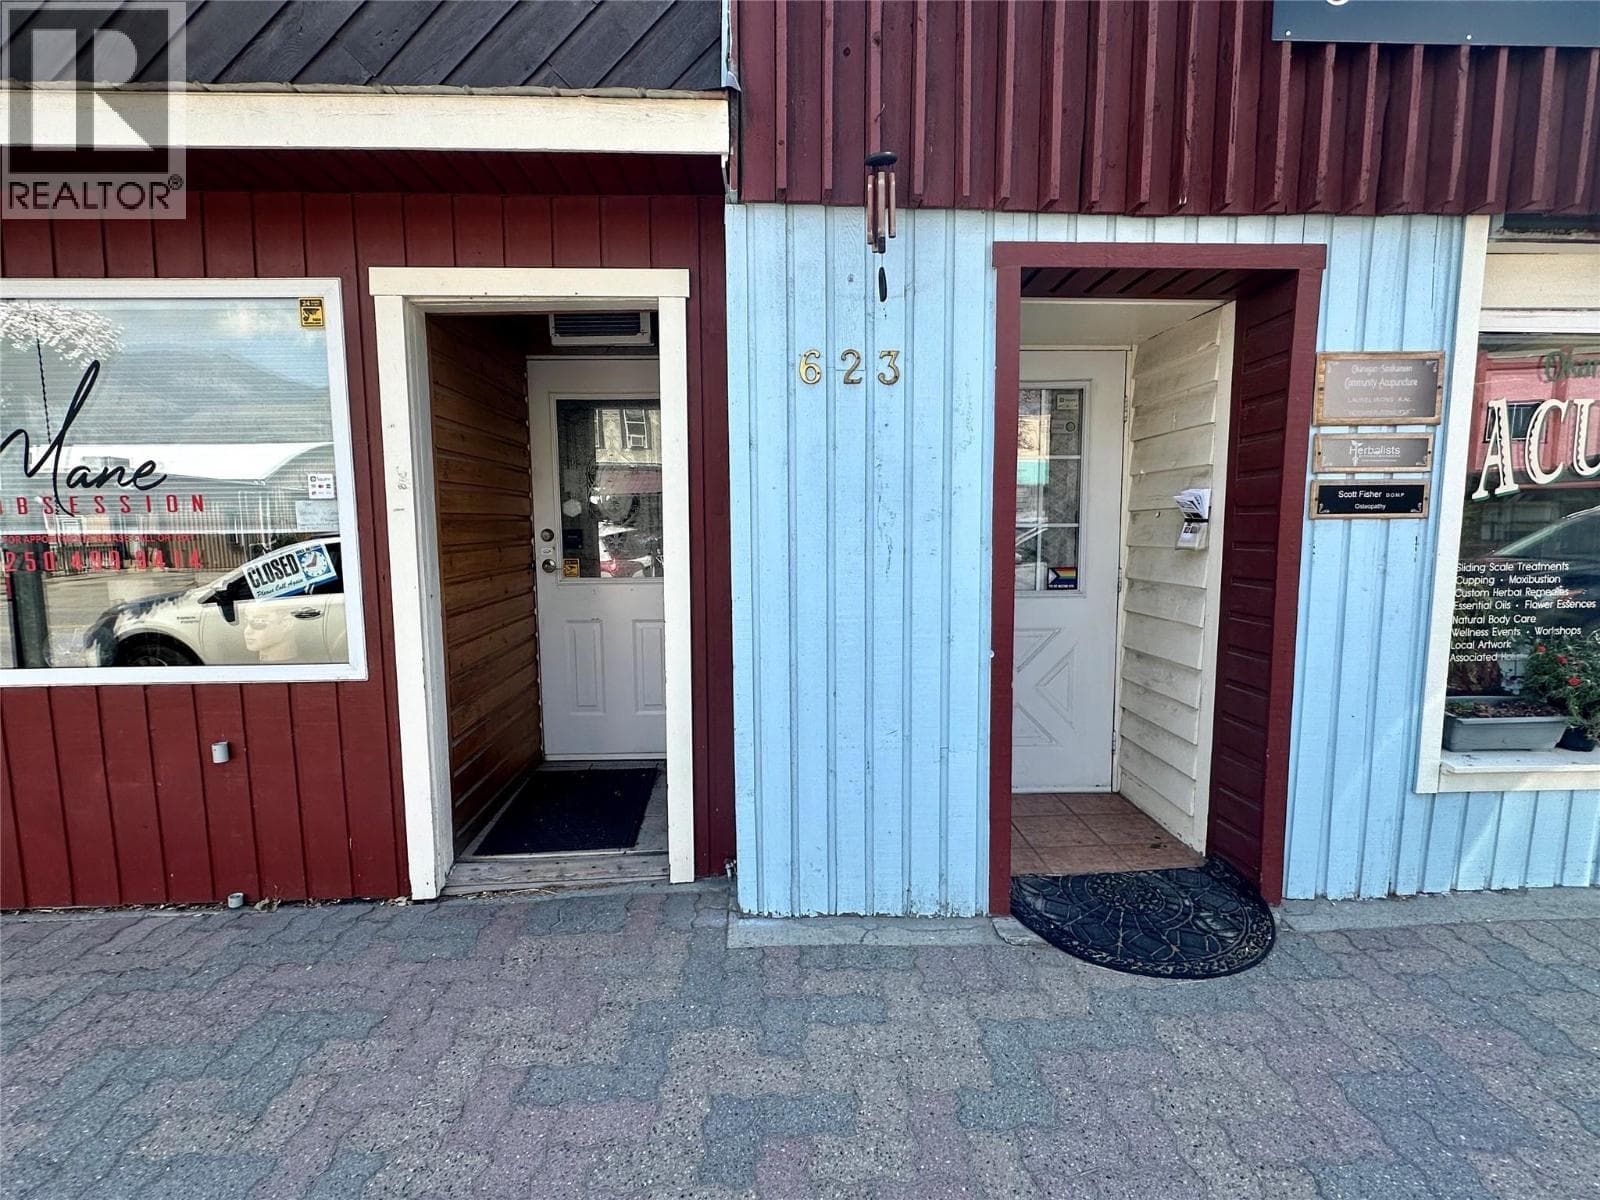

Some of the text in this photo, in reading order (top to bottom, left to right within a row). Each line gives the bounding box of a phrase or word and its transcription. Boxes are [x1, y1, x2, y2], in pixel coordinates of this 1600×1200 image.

[1344, 376, 1419, 390] Community Acupuncture
[1349, 443, 1401, 458] Herbalists
[1338, 490, 1357, 498] Scott
[1359, 490, 1382, 498] Fisher
[0, 494, 204, 515] BSESSION
[1355, 503, 1386, 511] Osteopathy
[5, 551, 57, 573] 250
[1457, 561, 1570, 574] Sliding Scale Treatments
[247, 553, 300, 589] CLOSED
[1456, 574, 1561, 587] Cupping Moxibustion
[275, 582, 287, 592] Call
[1455, 586, 1570, 598] Custom Herbal Remedies
[1455, 599, 1597, 610] Essential Oils Flower Essences
[1452, 614, 1537, 626] Natural Body Care
[1451, 626, 1582, 637] Wellness Events Workshops
[1450, 640, 1512, 650] Local Artwork
[1450, 652, 1498, 662] Associated
